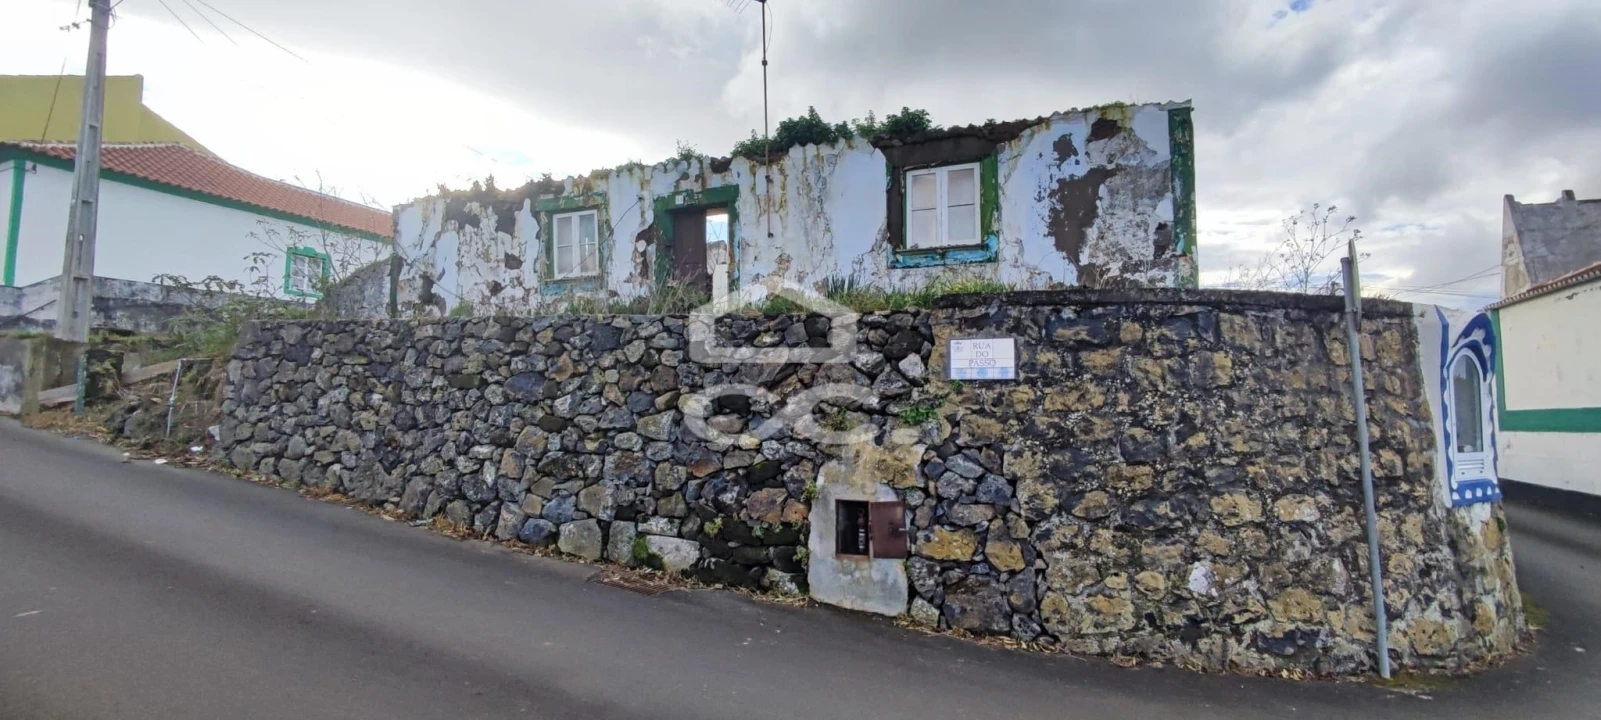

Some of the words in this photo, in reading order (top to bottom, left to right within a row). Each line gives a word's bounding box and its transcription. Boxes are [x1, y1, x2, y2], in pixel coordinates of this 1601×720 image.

[972, 342, 992, 350] RUA
[975, 350, 989, 358] DO
[968, 359, 997, 367] PASSO
